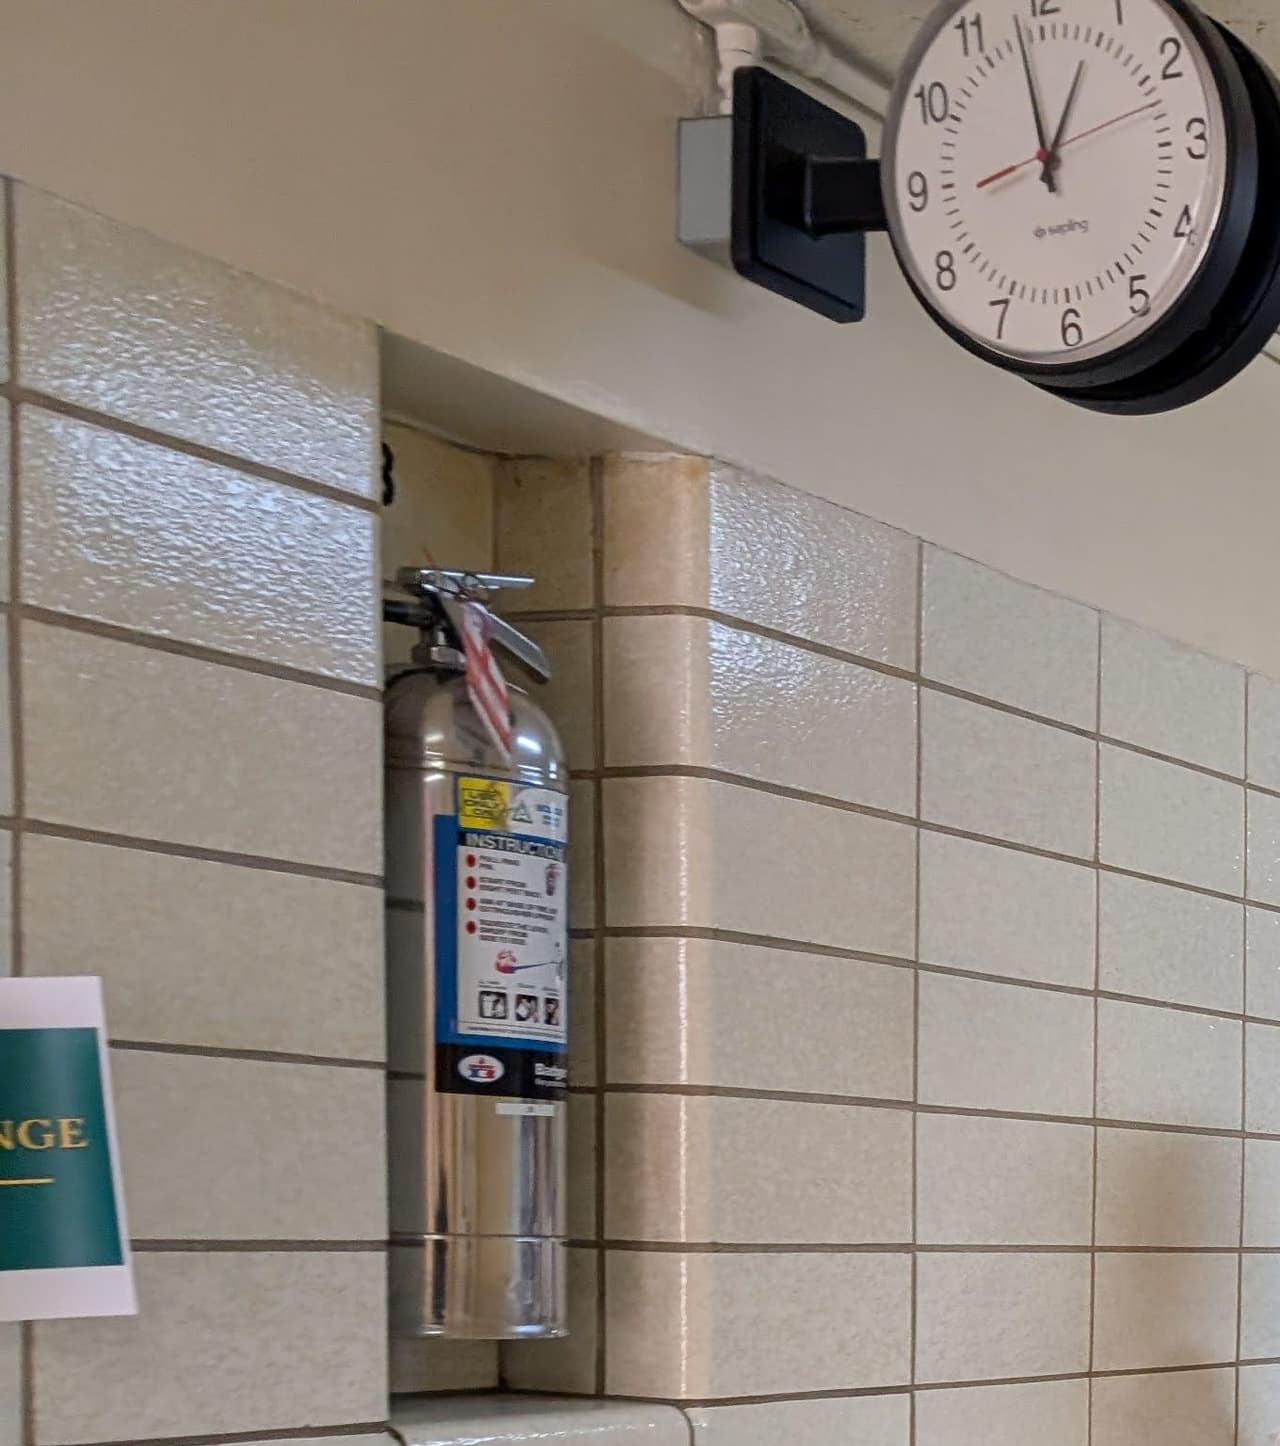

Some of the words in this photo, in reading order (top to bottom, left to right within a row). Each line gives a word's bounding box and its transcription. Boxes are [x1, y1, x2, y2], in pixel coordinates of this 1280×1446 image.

[954, 13, 985, 57] 11
[1160, 37, 1183, 80] 2
[914, 81, 948, 124] 10
[1185, 118, 1208, 160] 3
[908, 172, 927, 212] 9
[1174, 204, 1195, 242] 4
[935, 251, 957, 291] 8
[1129, 275, 1151, 317] 5
[989, 299, 1011, 340] 7
[1062, 308, 1083, 347] 6
